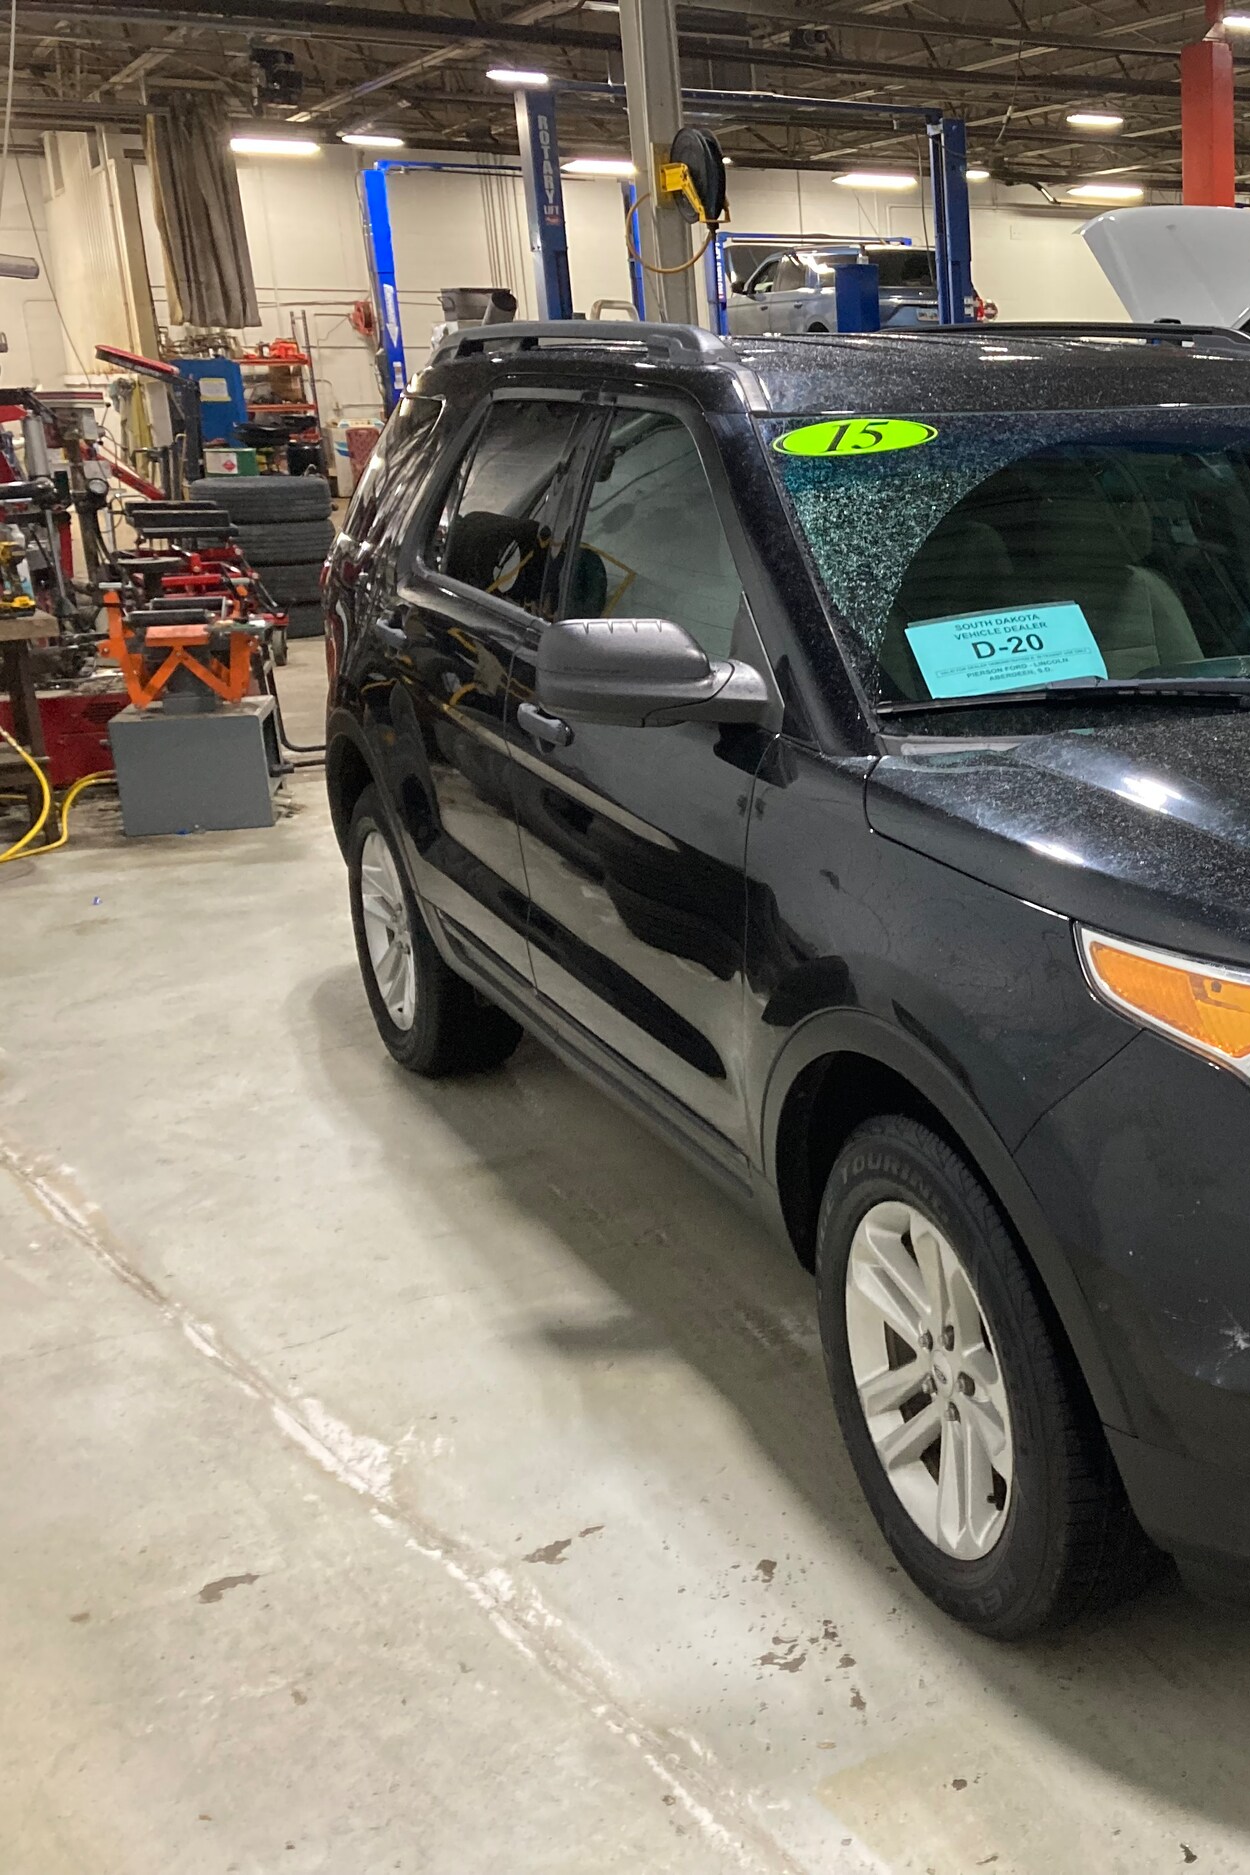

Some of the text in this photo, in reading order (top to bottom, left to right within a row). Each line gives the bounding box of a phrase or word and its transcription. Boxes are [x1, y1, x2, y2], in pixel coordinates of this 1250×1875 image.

[537, 114, 555, 204] ROTARY
[543, 204, 559, 215] LIFT
[821, 421, 889, 453] 15
[954, 622, 1048, 640] VEHICLE DEALER
[955, 614, 1040, 631] SOUTH DAKOTA
[971, 633, 1044, 660] D-20
[966, 667, 1003, 678] PIERSON
